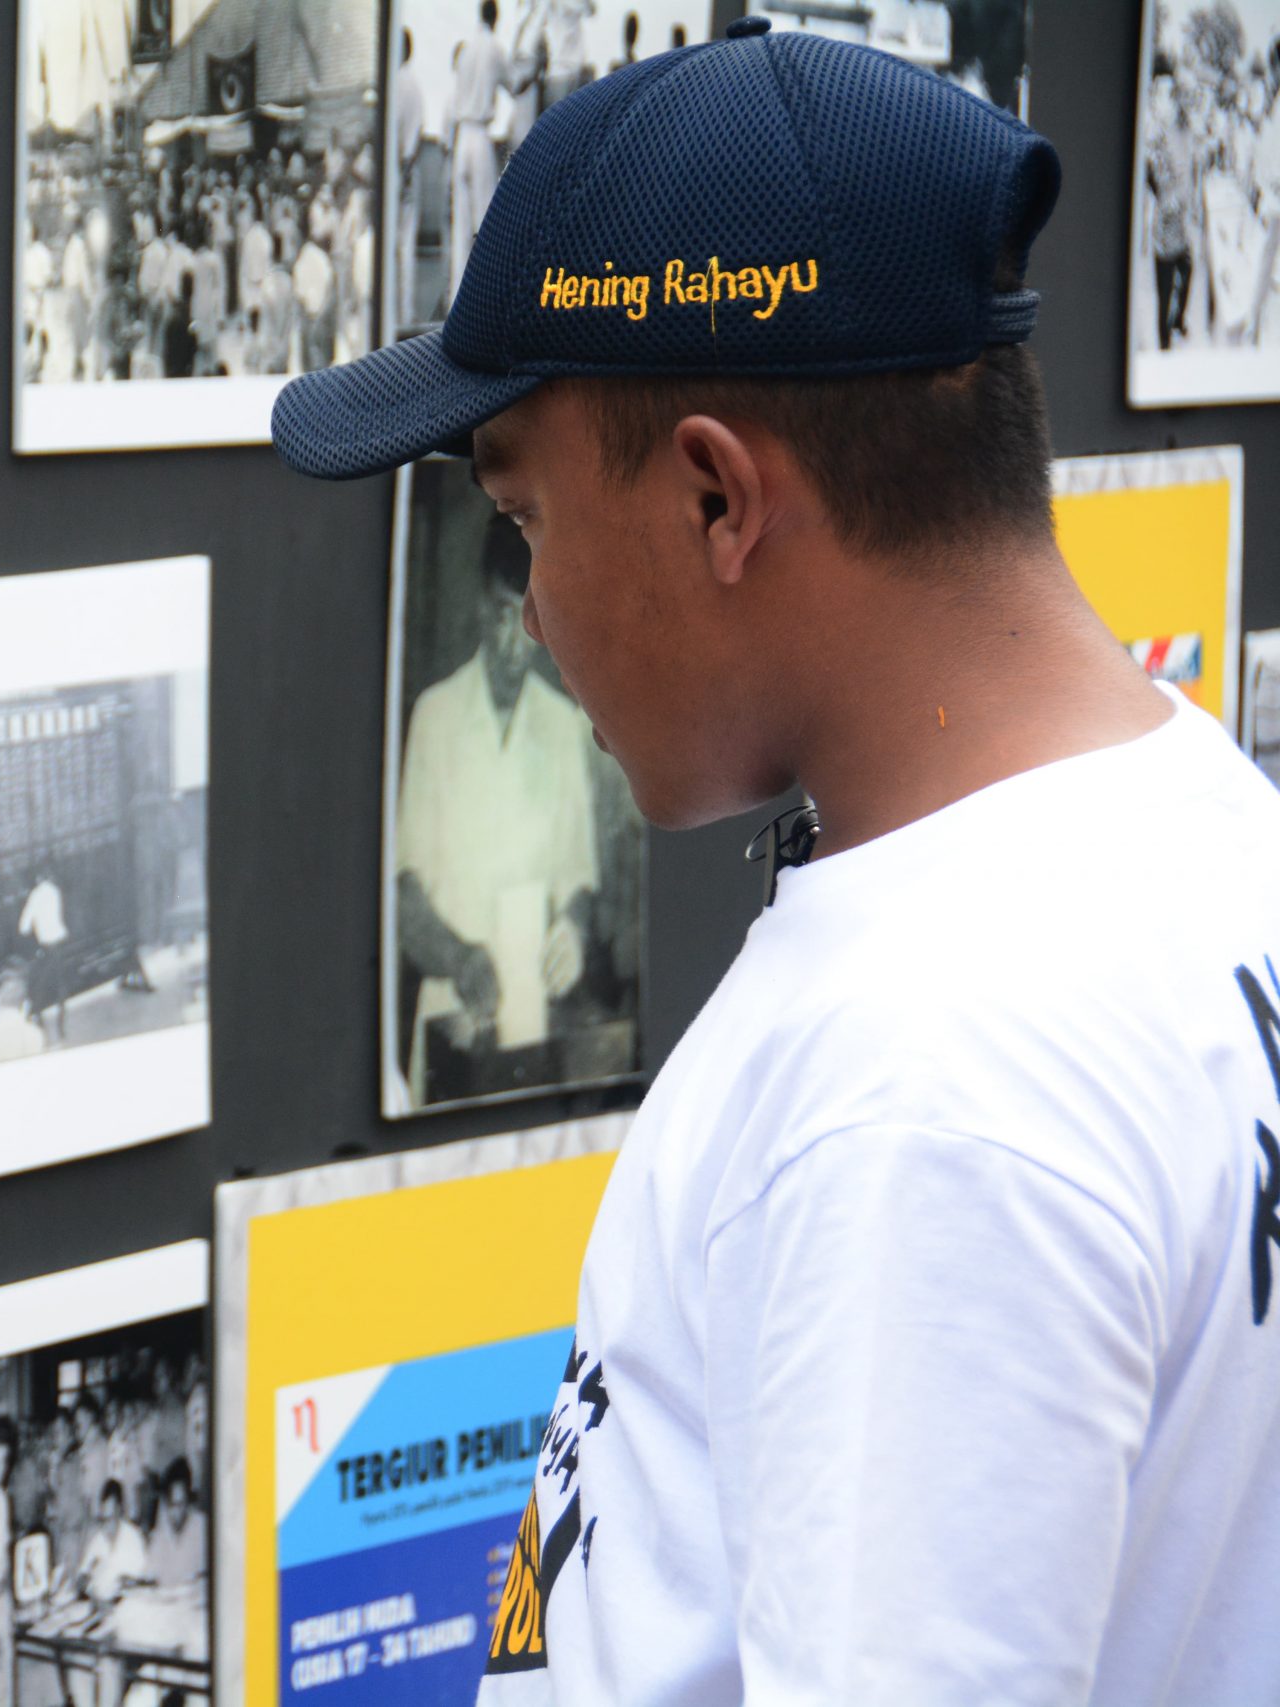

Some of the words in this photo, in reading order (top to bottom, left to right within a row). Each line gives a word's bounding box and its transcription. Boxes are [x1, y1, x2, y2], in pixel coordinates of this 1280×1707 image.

[540, 261, 649, 320] Hening
[665, 256, 818, 320] Rahayu
[338, 1436, 448, 1504] TERGIUR
